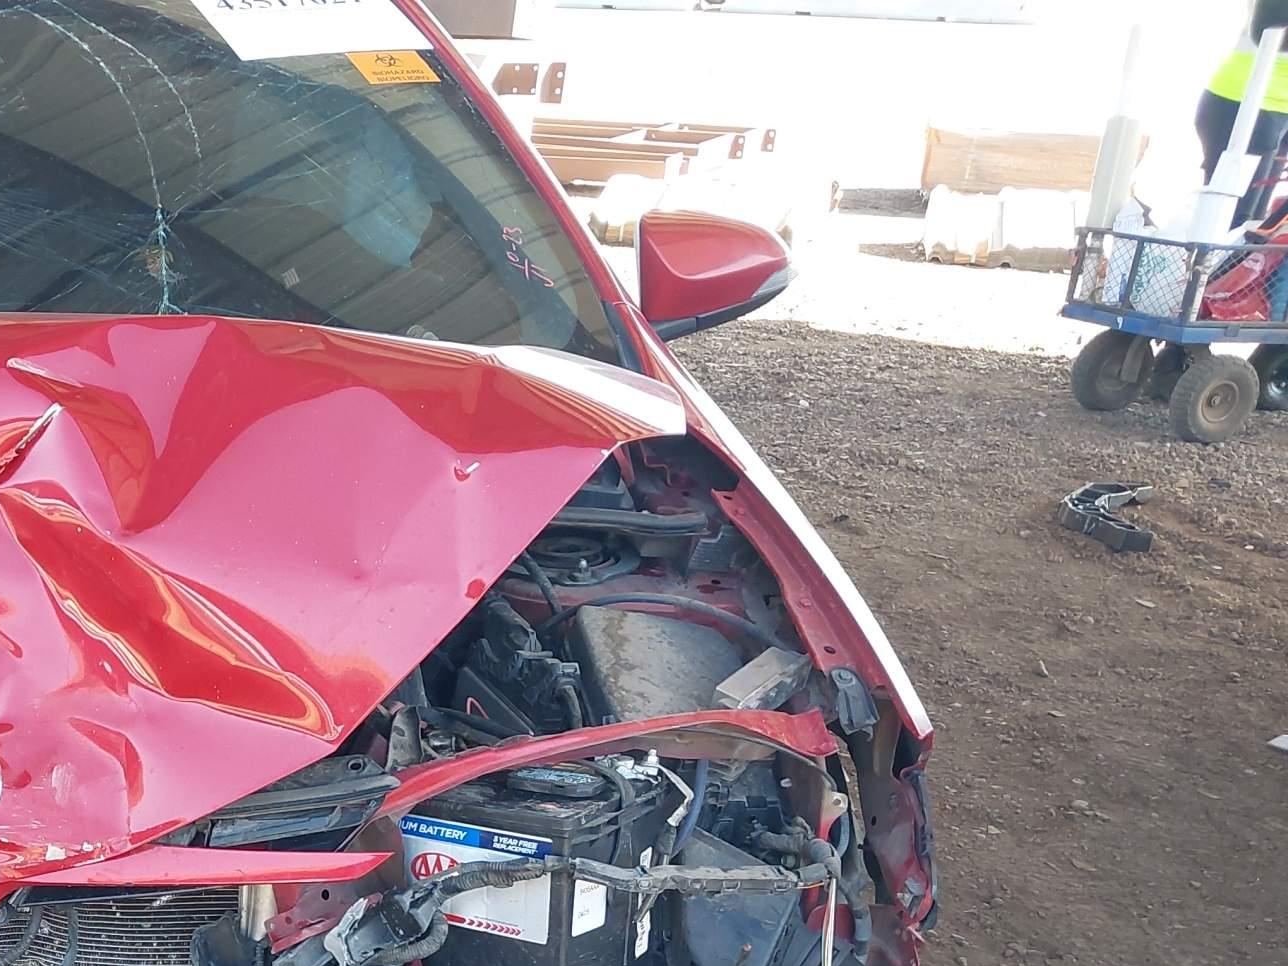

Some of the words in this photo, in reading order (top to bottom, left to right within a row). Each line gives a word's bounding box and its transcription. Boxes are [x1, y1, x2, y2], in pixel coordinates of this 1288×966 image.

[418, 823, 467, 840] BATTERY
[499, 836, 518, 846] YEAR
[518, 839, 539, 850] FREE
